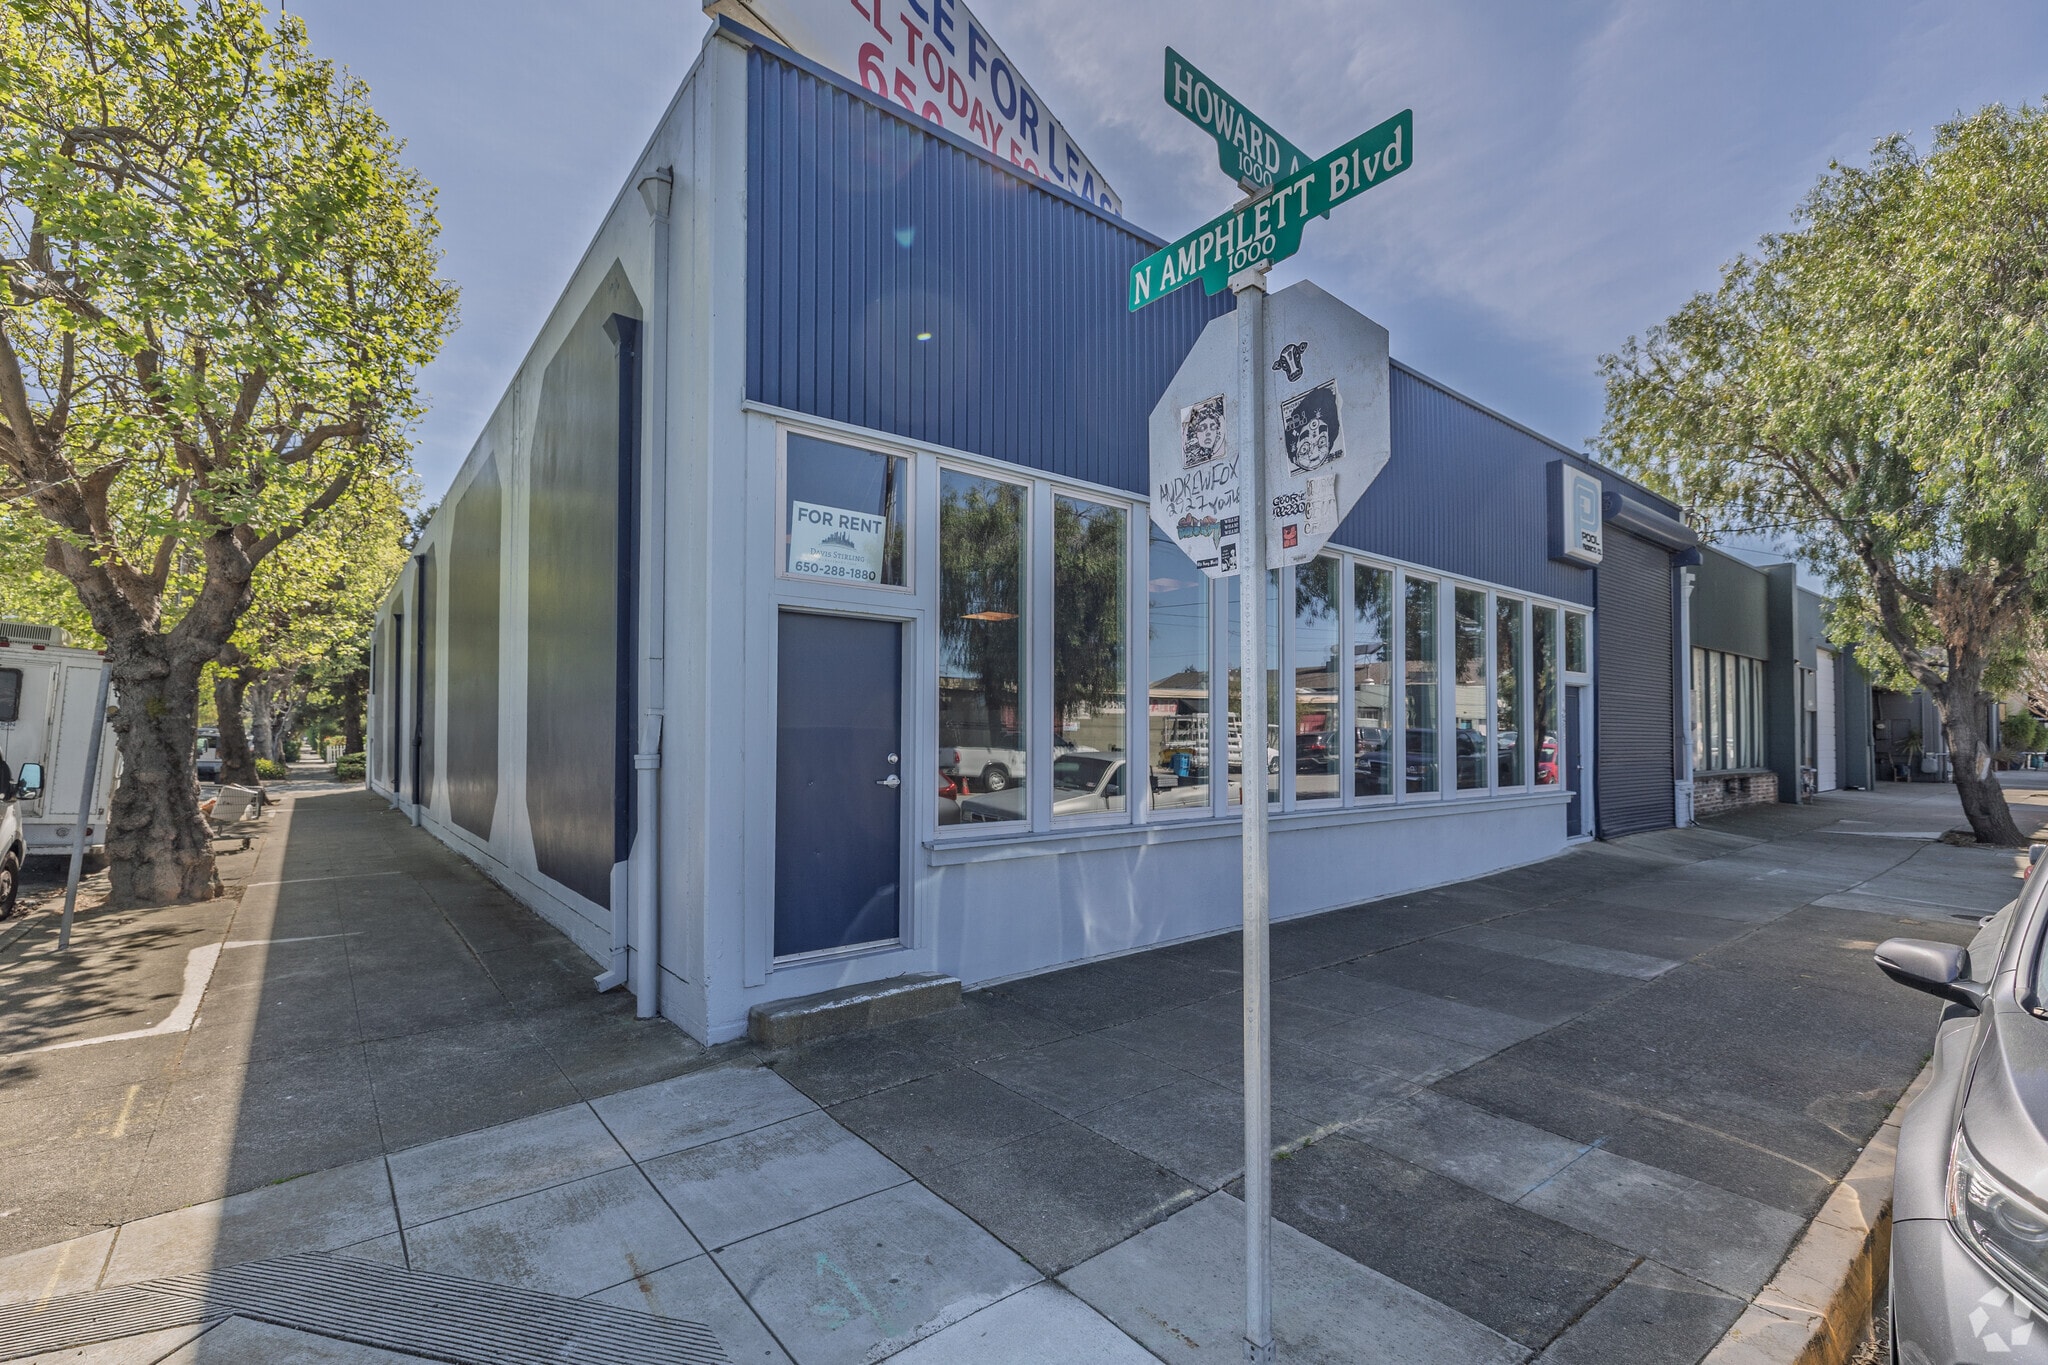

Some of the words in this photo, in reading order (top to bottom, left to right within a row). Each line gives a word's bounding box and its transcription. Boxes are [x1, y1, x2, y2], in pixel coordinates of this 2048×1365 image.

[900, 12, 1004, 156] TODAY
[968, 21, 1038, 156] FOR
[1048, 120, 1122, 218] LEAS
[1173, 61, 1280, 175] HOWARD
[1238, 152, 1272, 186] 1000
[1134, 265, 1151, 305] N
[1159, 173, 1315, 291] AMPHLETT
[1328, 124, 1403, 202] Blvd
[1228, 233, 1276, 273] 1000
[798, 507, 833, 527] FOR
[838, 514, 882, 534] RENT
[1581, 531, 1600, 546] POOL
[795, 561, 876, 581] 650-288-1880
